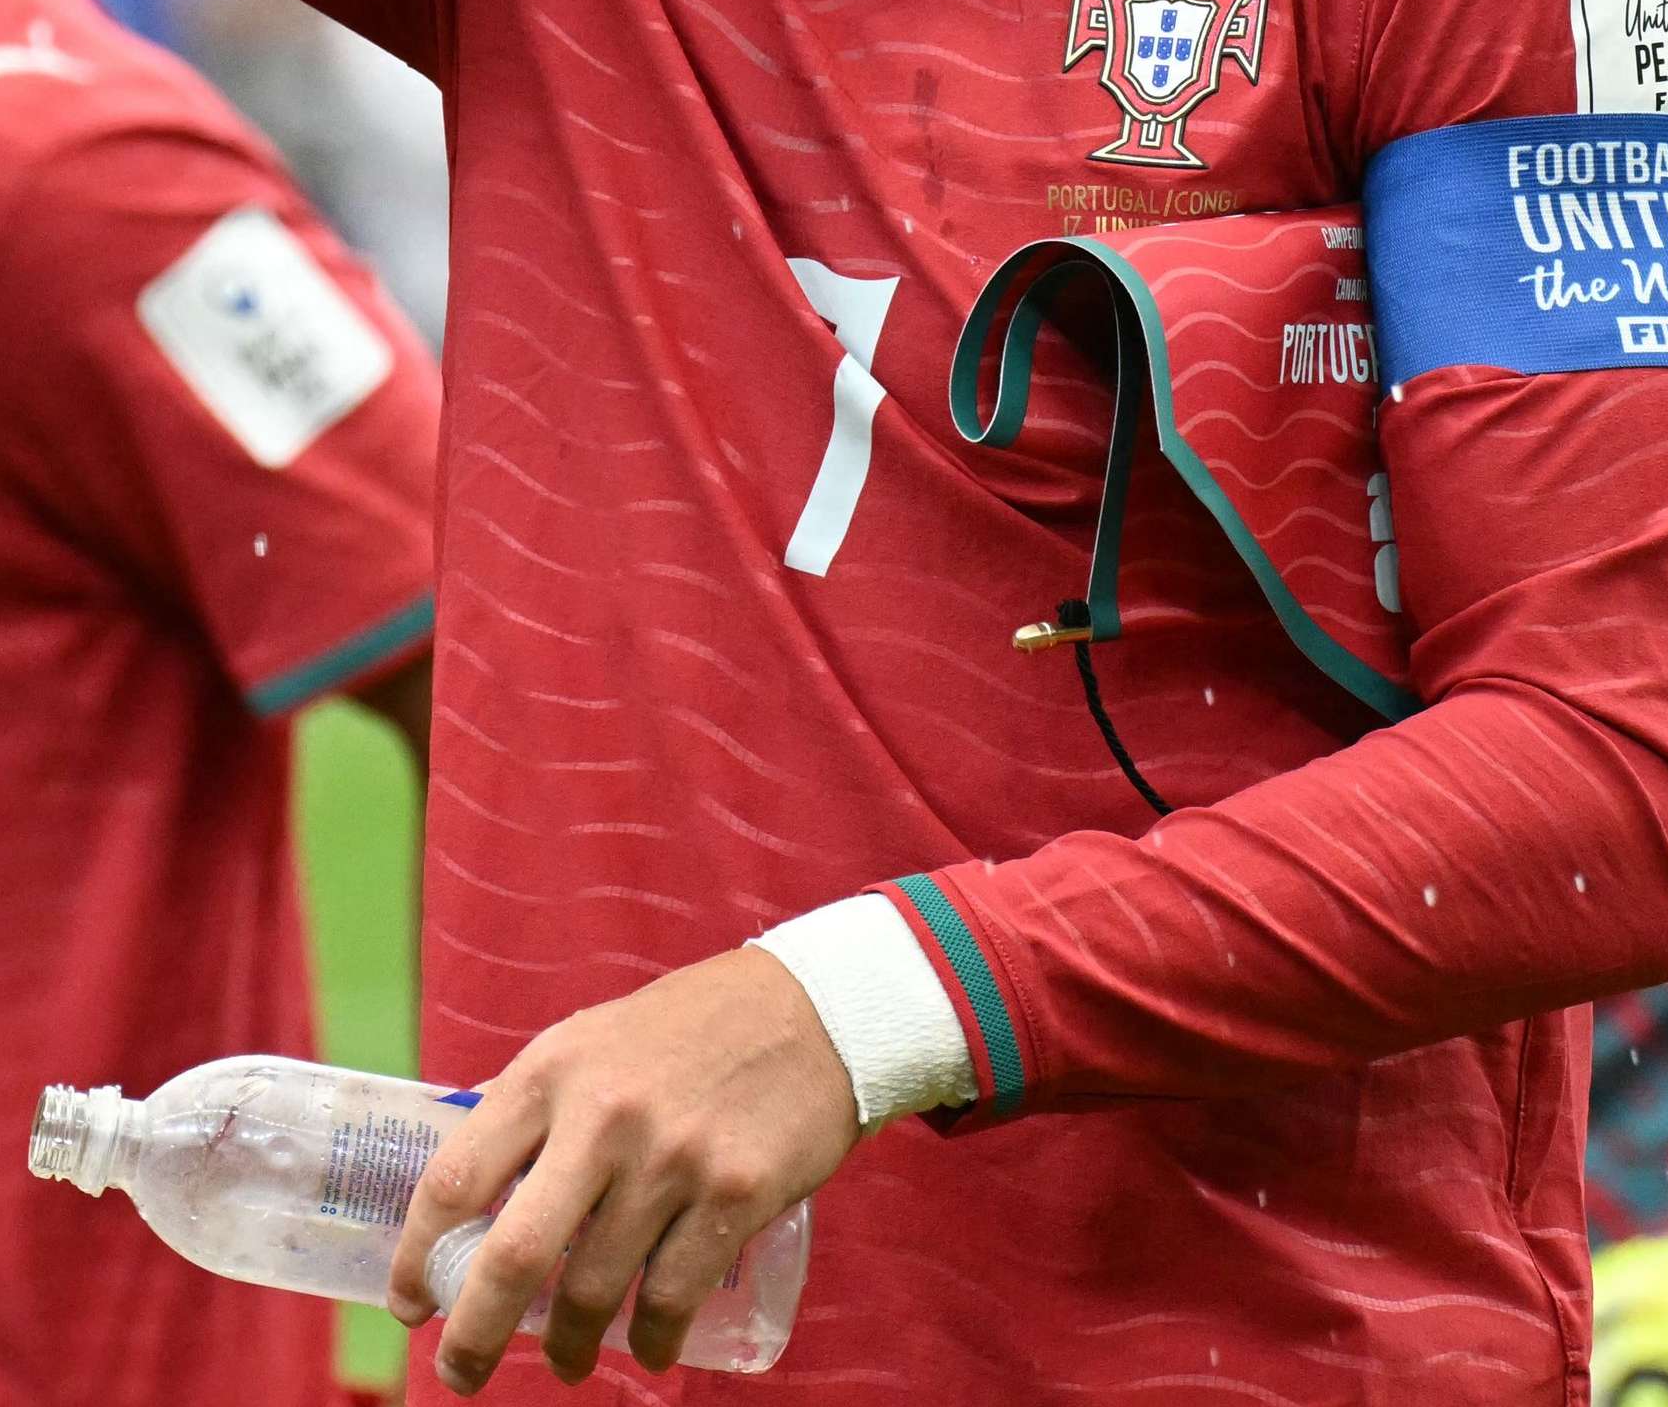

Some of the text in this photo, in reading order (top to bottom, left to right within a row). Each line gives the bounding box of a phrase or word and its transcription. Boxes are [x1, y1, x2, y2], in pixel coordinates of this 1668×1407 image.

[1063, 215, 1082, 237] 17
[1518, 258, 1620, 311] the
[783, 257, 901, 578] 7
